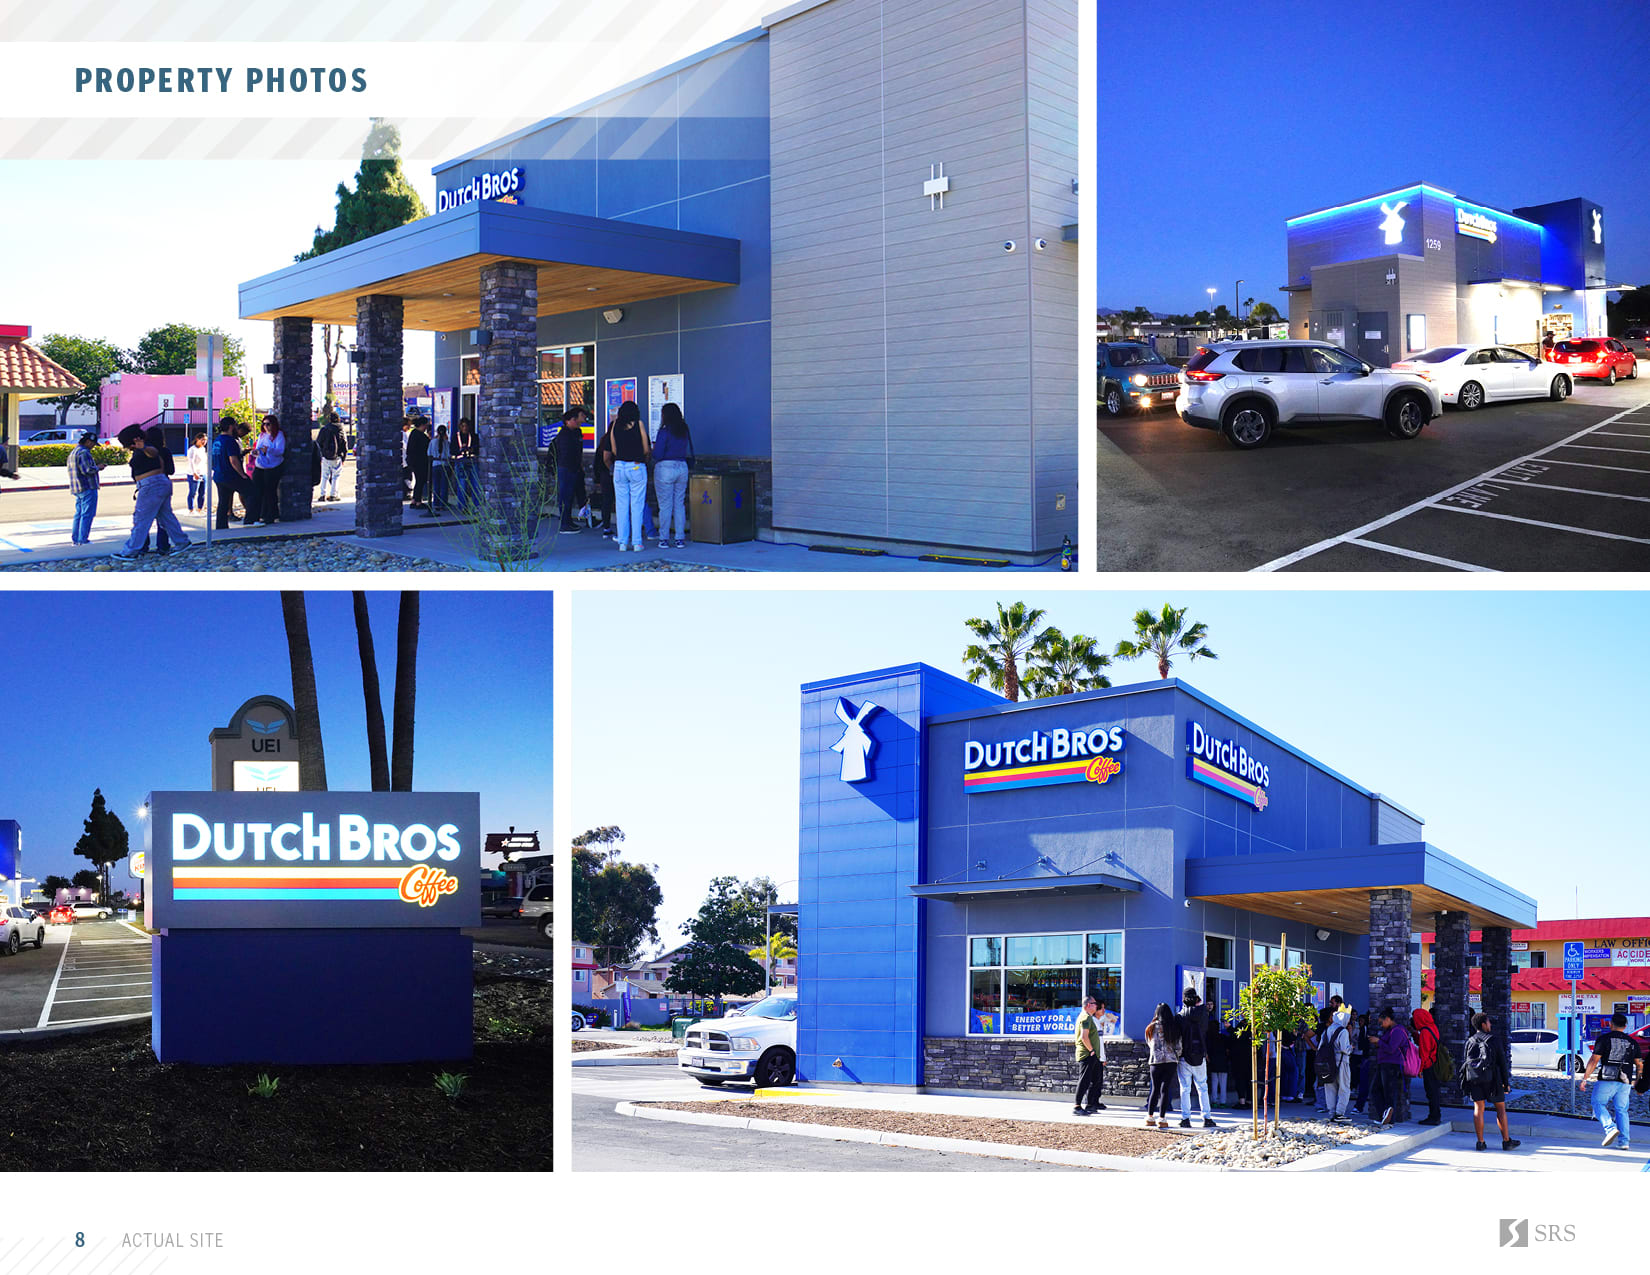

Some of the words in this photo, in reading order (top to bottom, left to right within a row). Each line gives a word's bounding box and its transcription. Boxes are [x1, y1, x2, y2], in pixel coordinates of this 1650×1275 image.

[482, 167, 519, 200] BROS
[1426, 238, 1442, 251] 1259
[252, 739, 281, 753] UEI
[964, 730, 1048, 770] DUTCH
[1051, 726, 1123, 759] BROS
[1193, 721, 1238, 773] DUTCH
[1239, 745, 1270, 788] BROS
[1086, 756, 1121, 784] Coffee
[172, 811, 331, 861] DUTCH
[339, 813, 461, 861] BROS
[400, 865, 457, 905] Coffee
[1594, 940, 1616, 949] LAW
[1011, 1023, 1042, 1032] BETTER
[1043, 1022, 1075, 1031] WORLD
[1015, 1015, 1047, 1024] ENERGY
[1048, 1014, 1065, 1023] FOR
[1066, 1014, 1072, 1022] A
